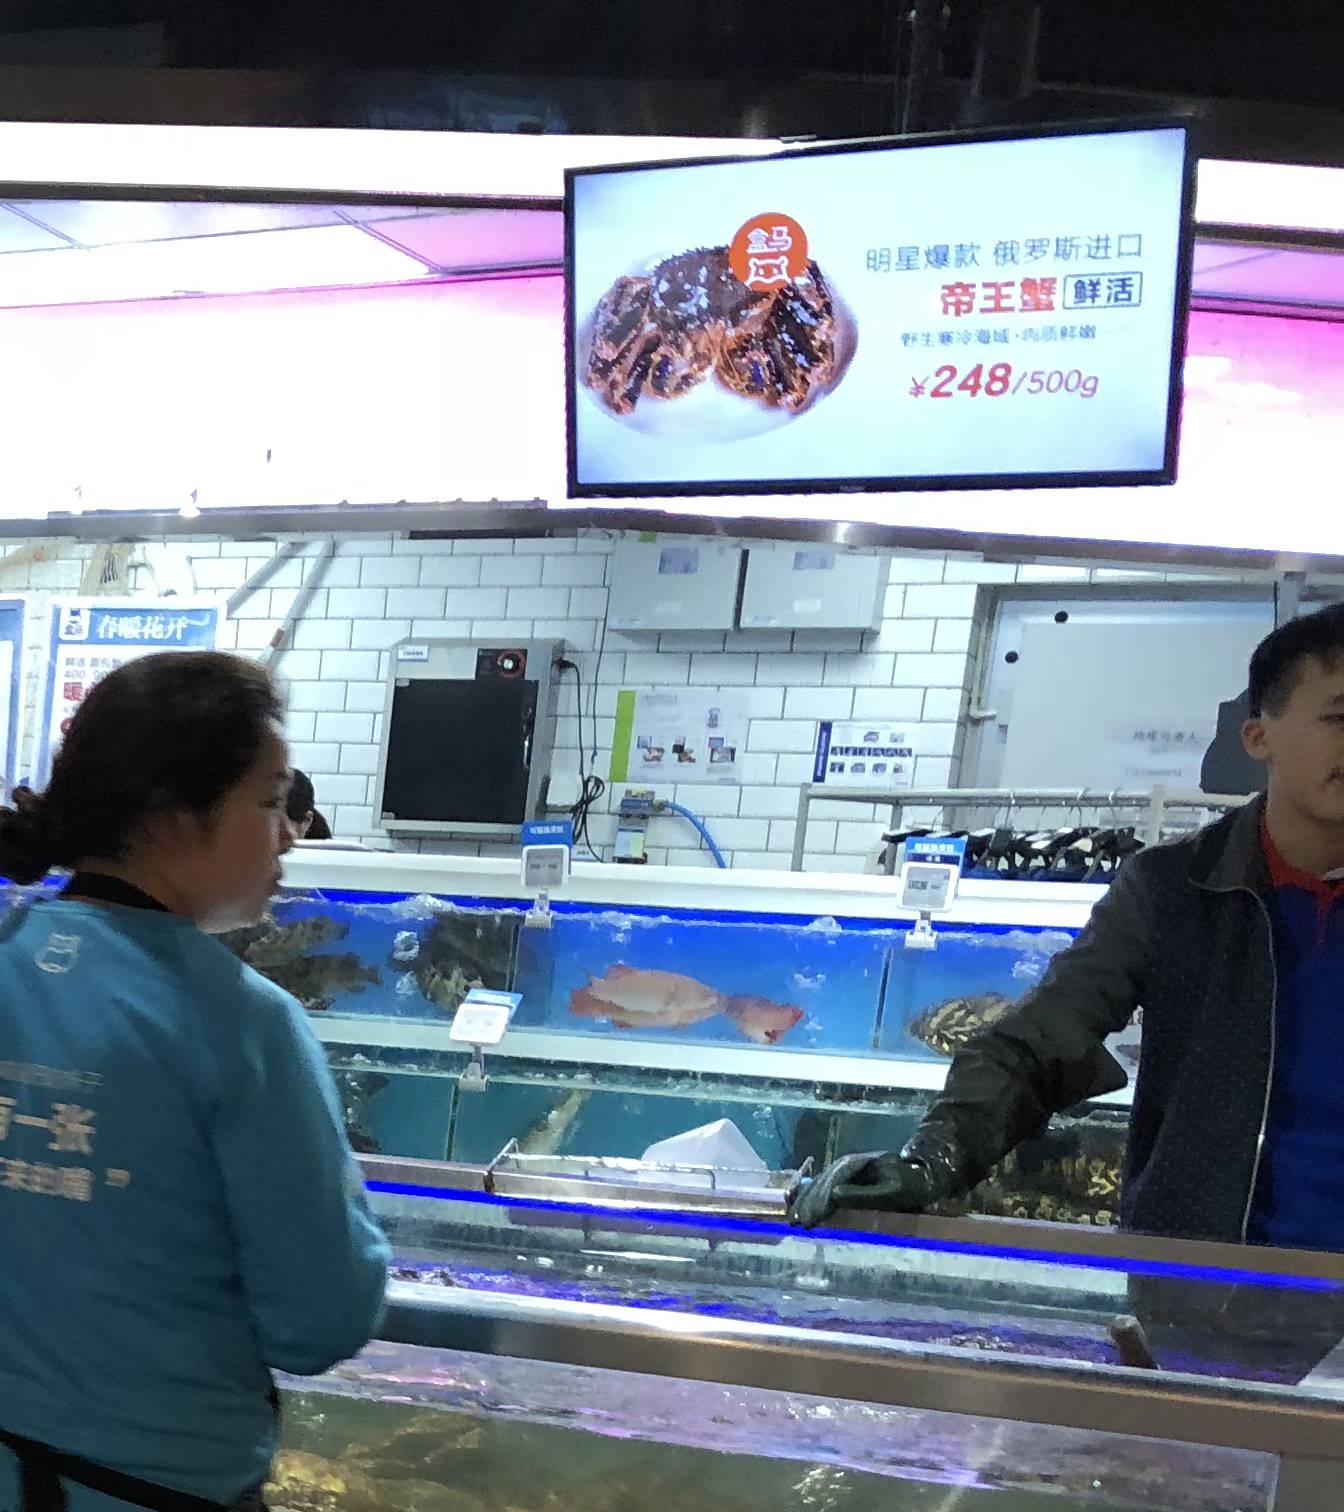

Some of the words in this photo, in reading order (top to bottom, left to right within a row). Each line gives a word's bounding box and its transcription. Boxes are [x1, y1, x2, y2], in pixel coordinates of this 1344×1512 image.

[866, 241, 981, 273] 明星爆款
[993, 233, 1142, 266] 俄罗斯进口
[940, 276, 1058, 317] 帝王蟹
[1073, 277, 1134, 305] 鲜活
